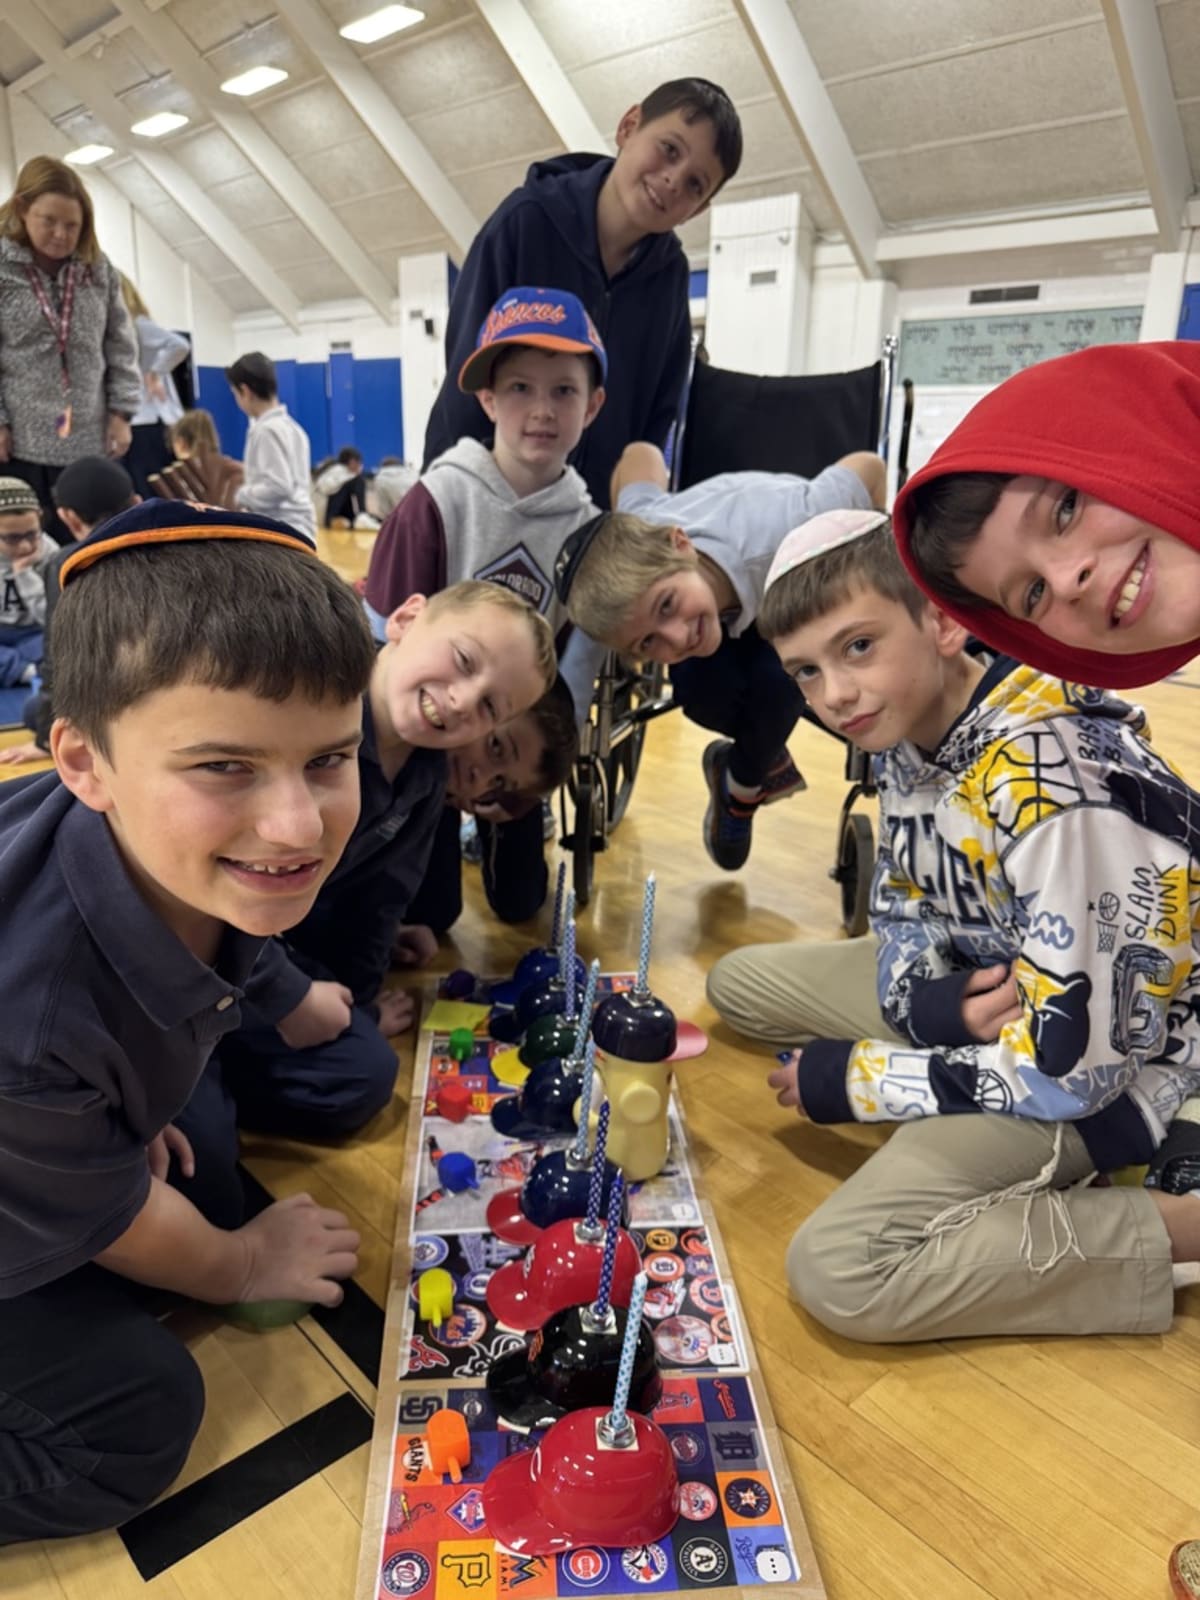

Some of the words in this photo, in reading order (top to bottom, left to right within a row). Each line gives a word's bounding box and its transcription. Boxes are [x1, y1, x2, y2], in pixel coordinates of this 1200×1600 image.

[1125, 866, 1155, 941] SLAM
[1154, 862, 1178, 941] DUNK
[405, 1437, 424, 1482] GIANTS
